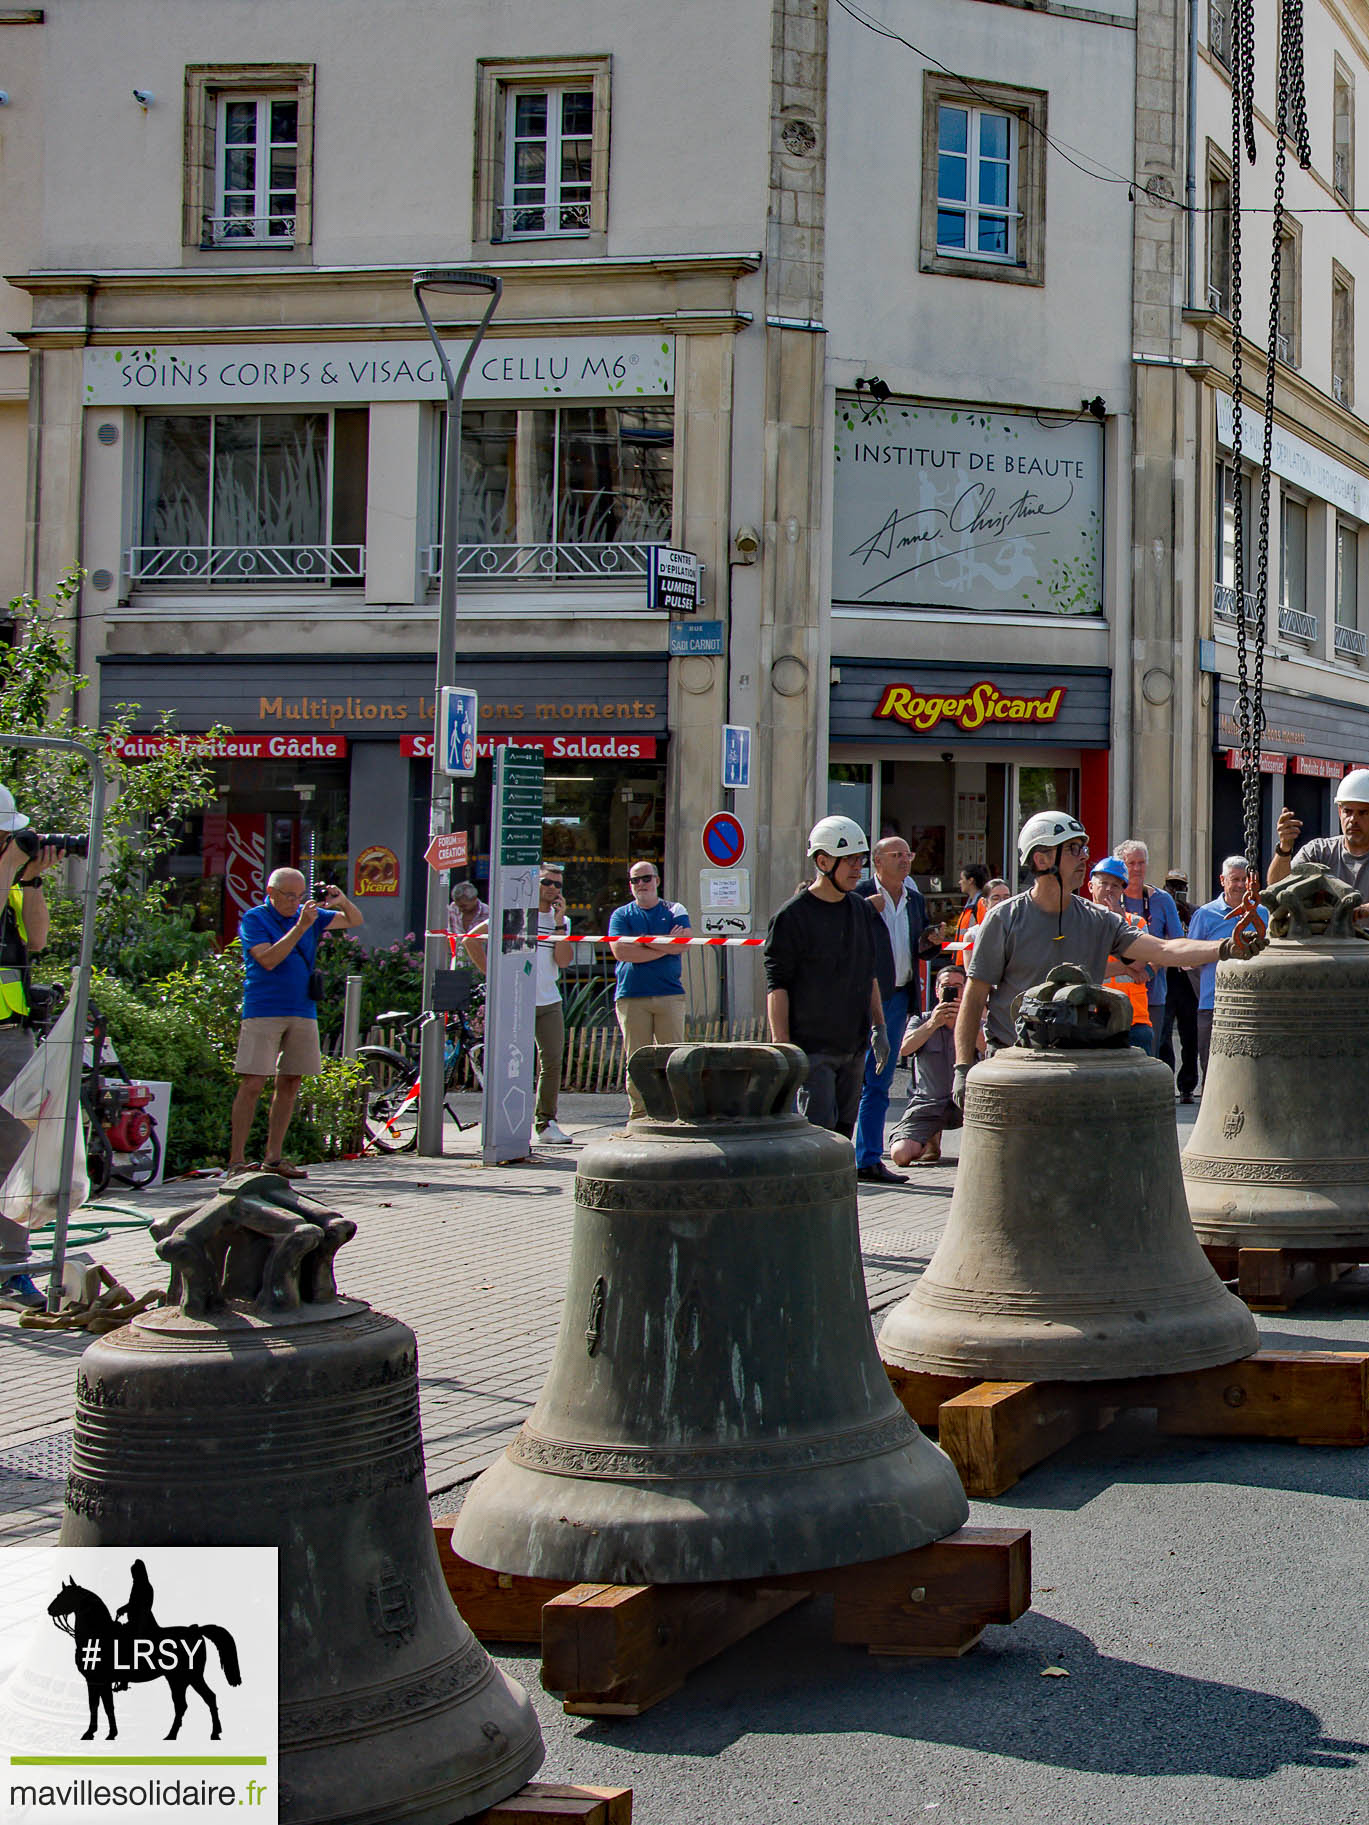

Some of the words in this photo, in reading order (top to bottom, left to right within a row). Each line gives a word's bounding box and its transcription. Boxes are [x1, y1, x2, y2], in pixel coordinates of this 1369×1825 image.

[122, 364, 208, 387] SOINS
[219, 362, 310, 386] CORPS
[321, 362, 338, 385] &
[481, 357, 568, 381] CELLU
[855, 444, 961, 469] INSTITUT
[969, 453, 995, 472] DE
[1005, 456, 1084, 479] BEAUTE
[669, 553, 692, 566] CENTRE
[661, 579, 695, 596] LUMIERE
[664, 594, 694, 610] PULSEE
[689, 639, 721, 650] CARNOT
[259, 697, 408, 729] Multiplions
[535, 700, 657, 719] moments
[268, 736, 337, 757] Gâche
[464, 743, 472, 759] 20
[552, 736, 641, 758] Salades
[438, 835, 457, 848] FORUM
[355, 878, 398, 896] Sicard
